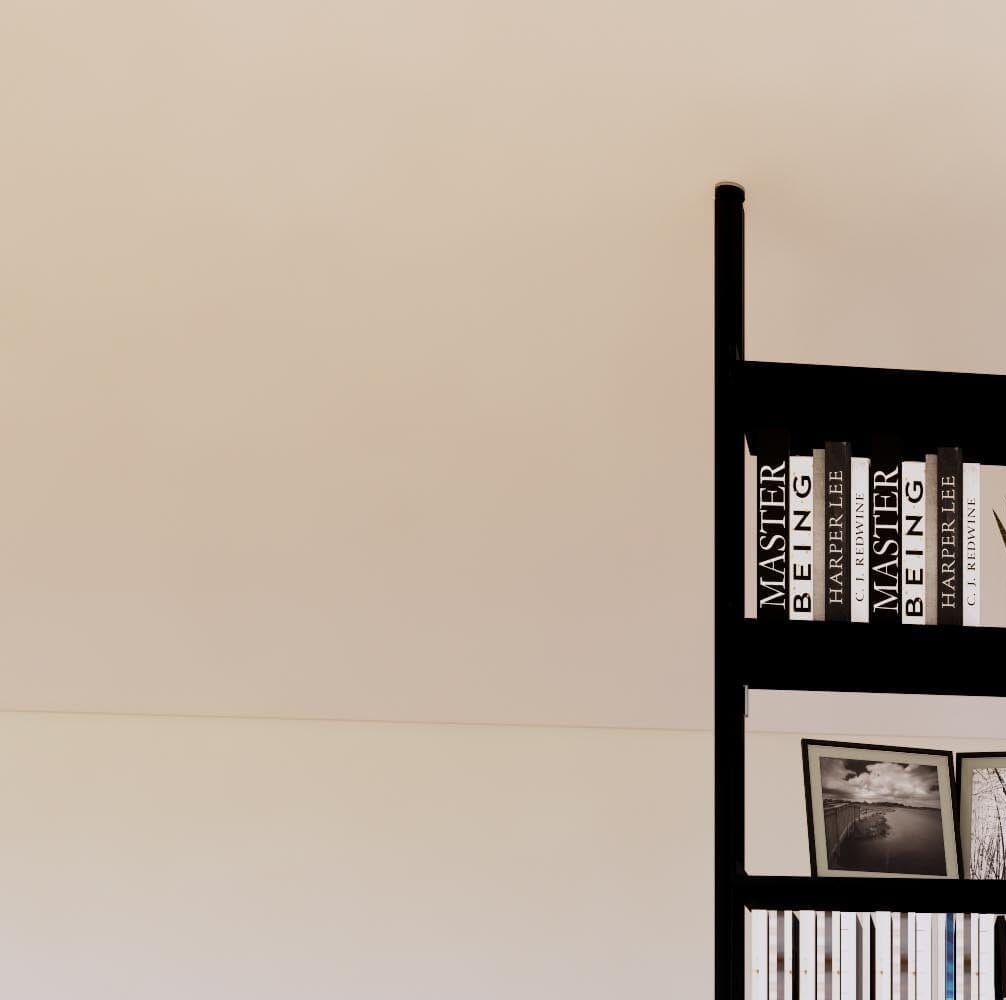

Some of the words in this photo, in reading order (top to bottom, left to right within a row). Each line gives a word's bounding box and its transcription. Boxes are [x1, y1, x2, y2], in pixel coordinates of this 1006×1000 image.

[829, 470, 843, 508] LEE
[855, 493, 864, 566] REDWINE
[941, 475, 956, 513] LEE
[759, 461, 786, 609] MASTER
[793, 475, 812, 613] BEING
[829, 514, 844, 604] HARPER
[872, 465, 899, 614] MASTER
[905, 480, 924, 617] BEING
[941, 519, 956, 609] HARPER
[967, 498, 976, 571] REDWINE
